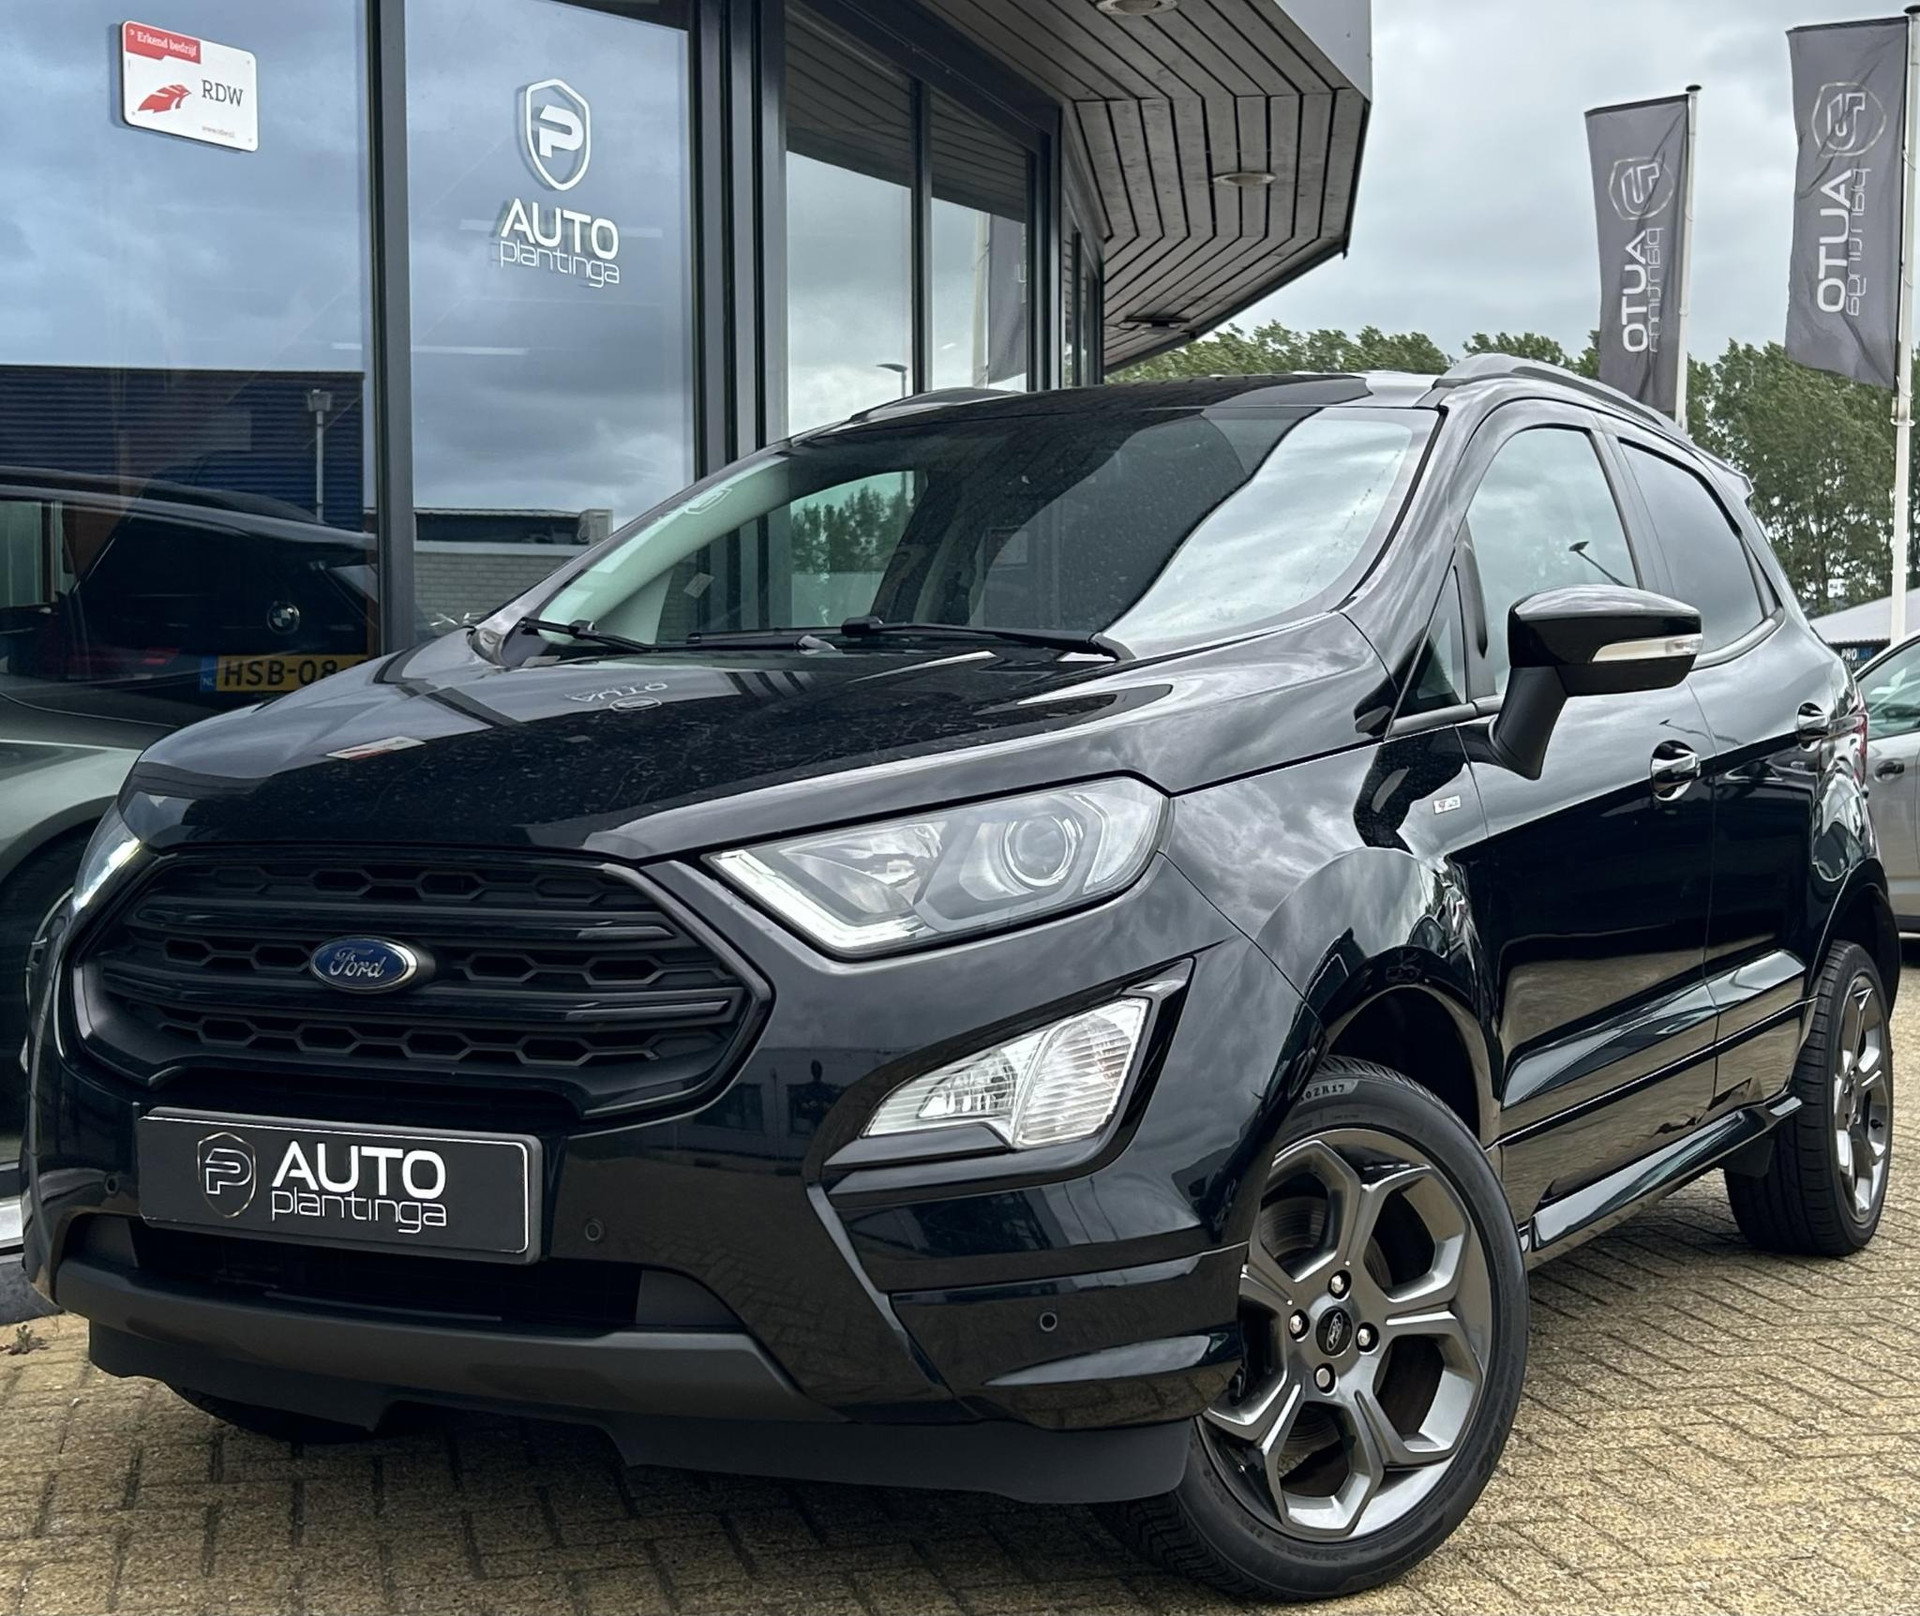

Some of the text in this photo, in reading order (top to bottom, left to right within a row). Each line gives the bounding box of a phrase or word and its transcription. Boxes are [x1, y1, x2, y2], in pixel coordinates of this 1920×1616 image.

[201, 79, 243, 106] RDW
[500, 198, 619, 260] AUTO
[500, 239, 620, 288] plantinga
[224, 660, 368, 686] HSB-08
[329, 947, 387, 978] Ford
[272, 1141, 447, 1199] AUTO
[272, 1187, 447, 1233] plantinga
